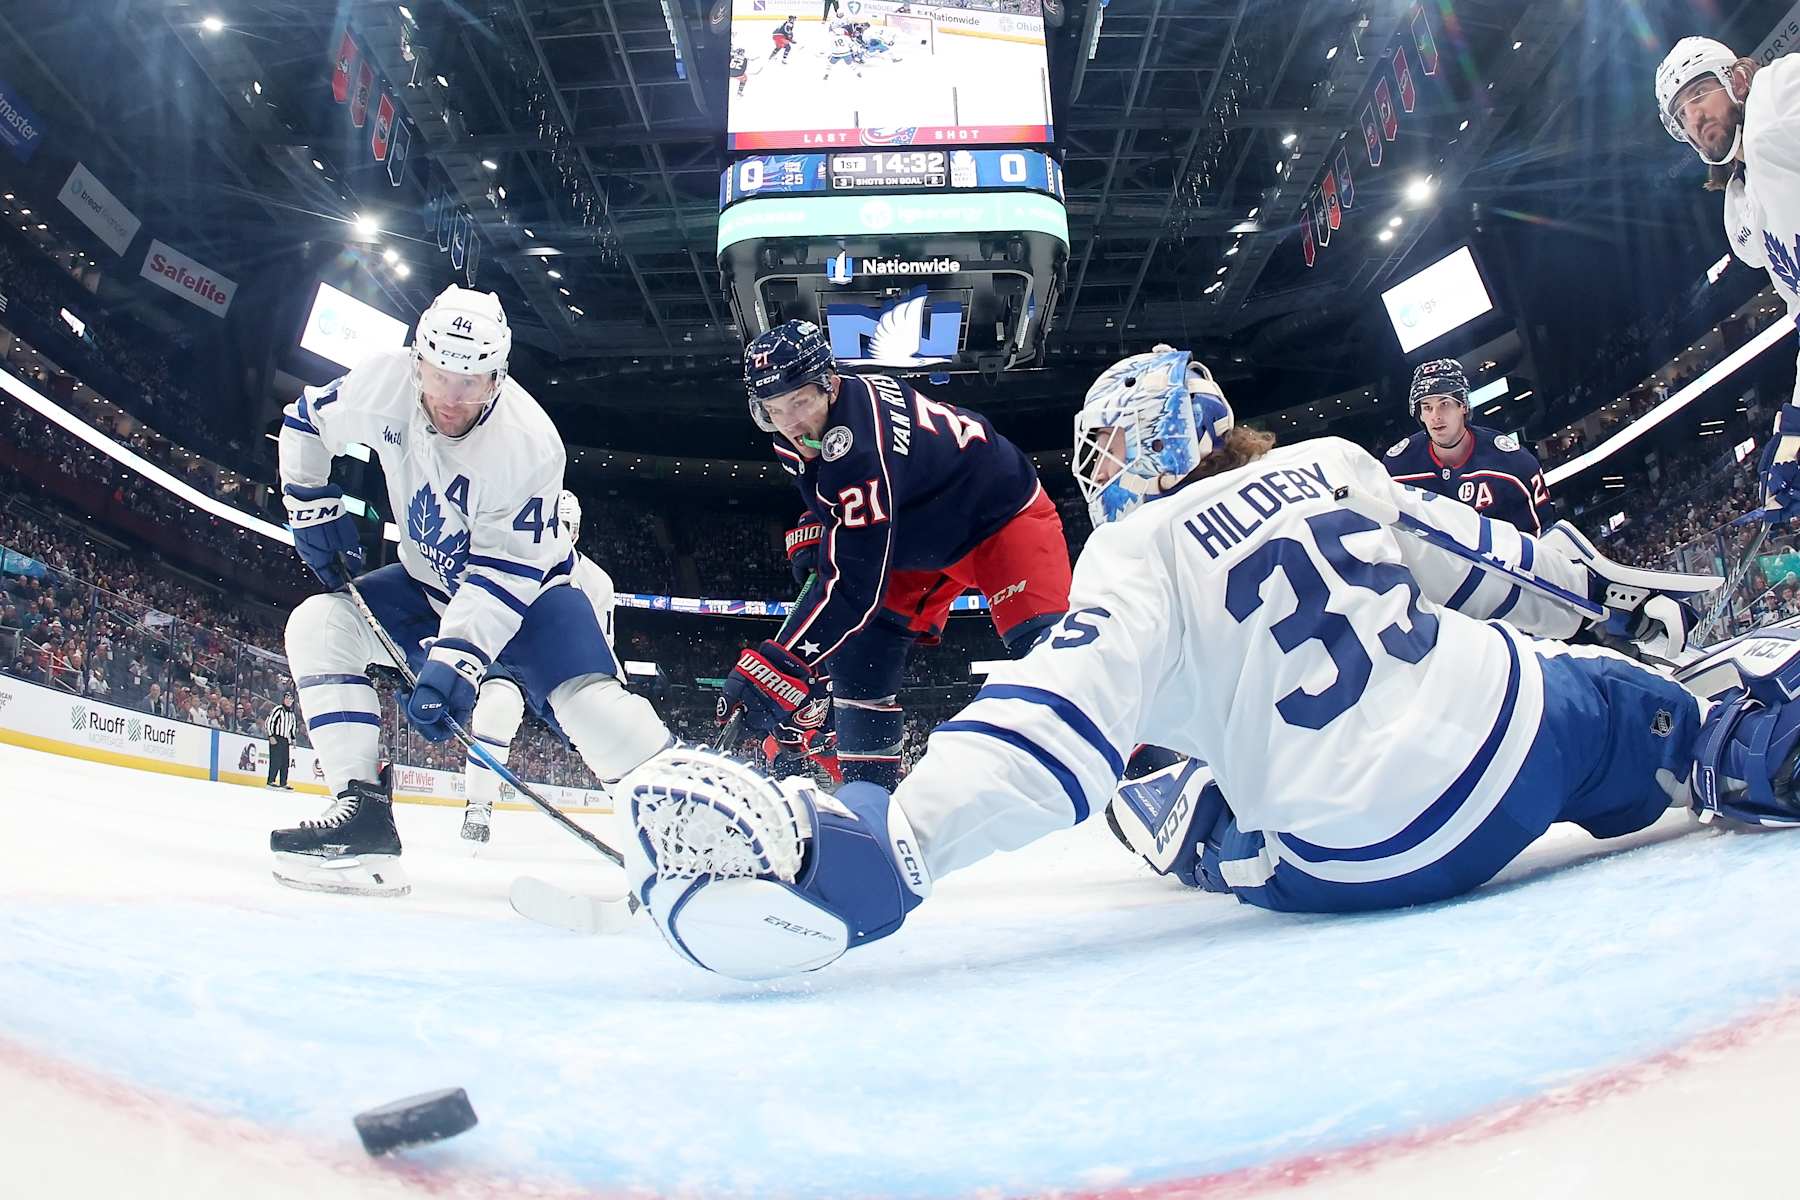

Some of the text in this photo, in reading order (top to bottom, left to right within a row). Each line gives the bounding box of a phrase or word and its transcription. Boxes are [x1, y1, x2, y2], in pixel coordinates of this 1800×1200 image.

[0, 93, 38, 140] master
[804, 130, 980, 143] LAST SHOT
[740, 160, 764, 191] 0
[841, 153, 945, 174] 1ST 14:32
[1000, 154, 1027, 182] 0
[900, 177, 922, 185] GOAL
[150, 254, 226, 304] Safelite
[862, 258, 961, 274] Nationwide
[452, 316, 472, 333] 44
[441, 350, 472, 361] CCM
[755, 373, 780, 387] CCM
[890, 409, 911, 456] VAN
[838, 479, 888, 528] 21
[1462, 484, 1472, 499] 13
[1475, 481, 1494, 510] A
[512, 493, 559, 544] 44
[1184, 462, 1336, 559] HILDEBY
[1224, 508, 1440, 730] 35
[89, 711, 125, 735] Ruoff
[144, 724, 176, 745] Ruoff
[400, 769, 415, 785] Jeff
[896, 839, 923, 886] CCM
